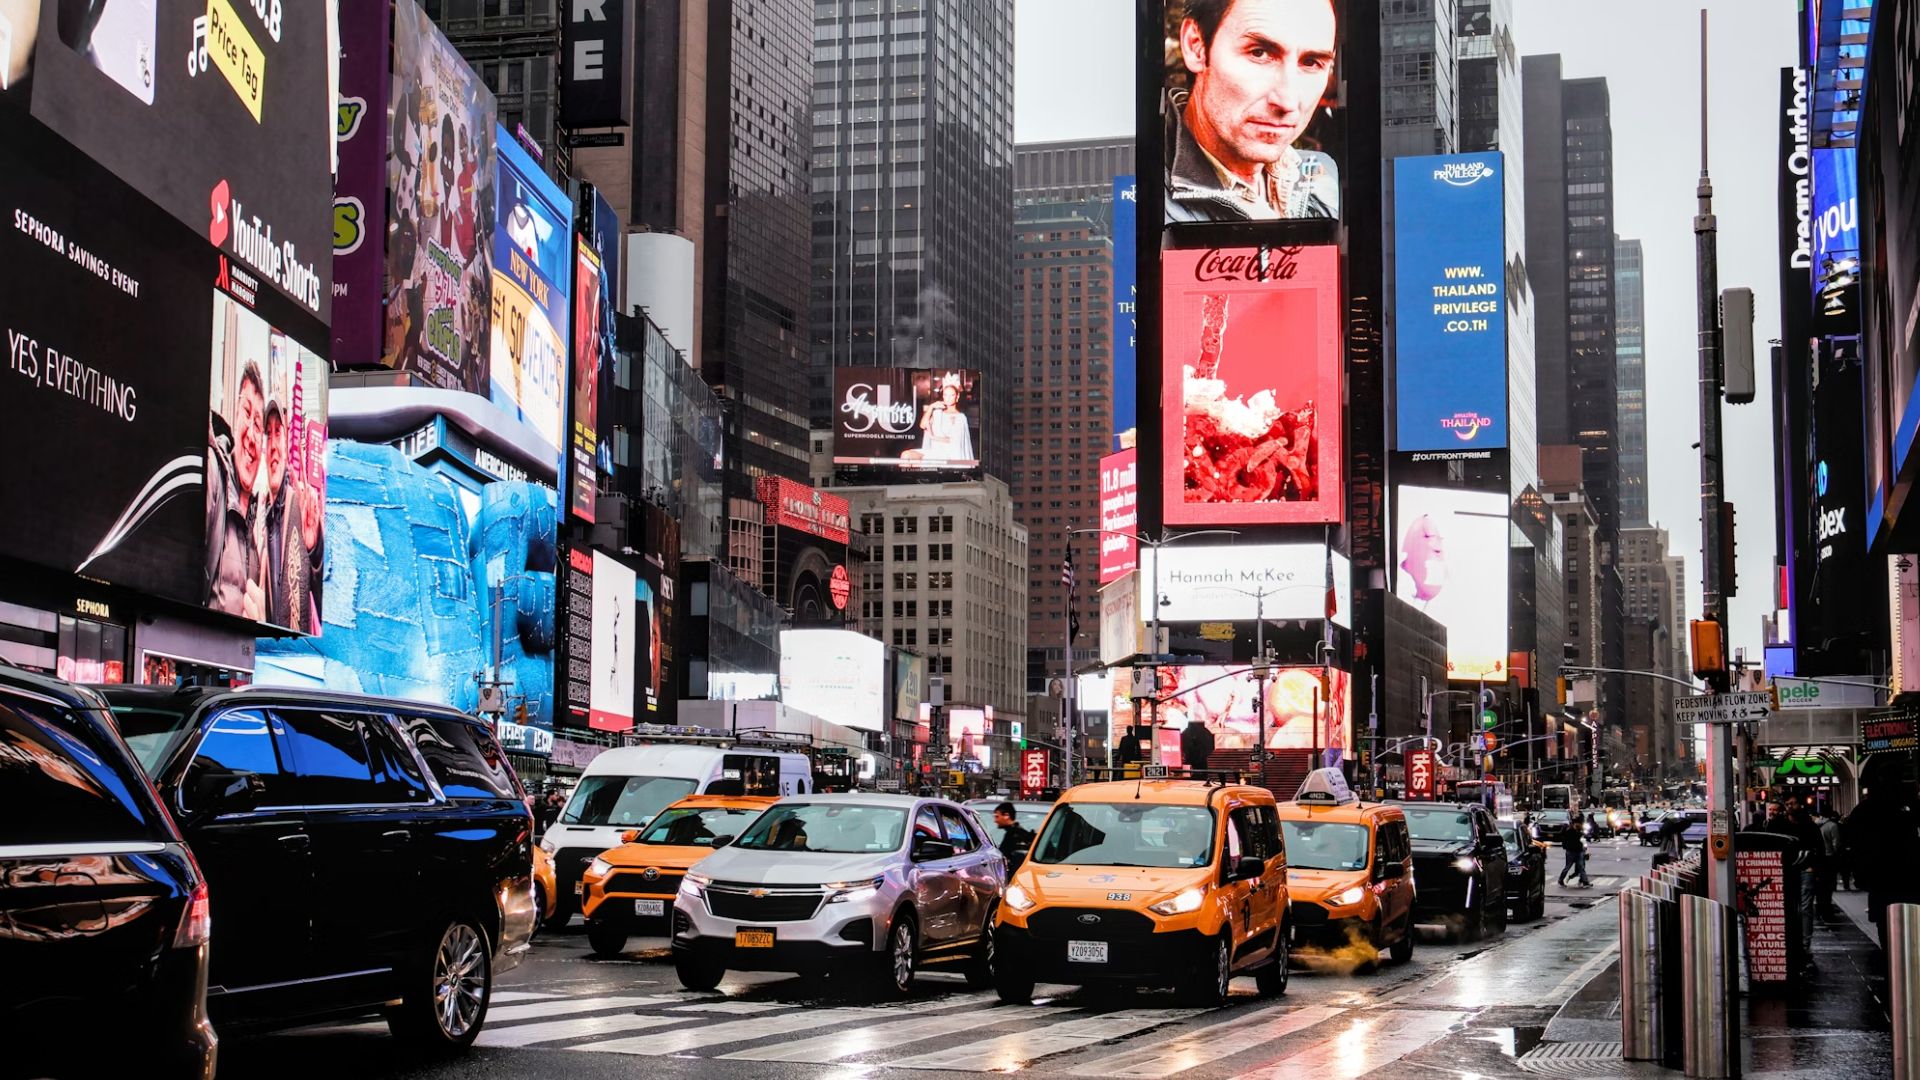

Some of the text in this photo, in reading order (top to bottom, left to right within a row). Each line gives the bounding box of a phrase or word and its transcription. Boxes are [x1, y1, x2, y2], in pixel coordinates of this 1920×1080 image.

[211, 7, 258, 101] Price Tag
[1434, 168, 1481, 180] PRIVILEGE
[1443, 162, 1485, 171] THAILAND
[1820, 198, 1857, 255] you
[14, 208, 140, 299] SEPHORA SAVINGS EVENT
[231, 198, 320, 312] YouTube Shorts
[231, 265, 259, 292] MARRIOTT
[510, 247, 550, 311] NEW YORK
[1444, 266, 1485, 279] WWW.
[1433, 283, 1497, 297] THAILAND
[493, 288, 506, 344] #1
[1433, 301, 1497, 315] PRIVILEGE
[1443, 319, 1488, 333] .CO.TH
[8, 328, 137, 422] YES, EVERYTHING
[1440, 418, 1491, 428] THAILAND
[475, 447, 509, 481] AMERICAN
[1412, 451, 1491, 461] #OUTFRONTPRIME
[1103, 468, 1119, 493] 11.8
[1170, 567, 1296, 584] Hannah McKee
[76, 599, 110, 618] SEPHORA
[1675, 693, 1770, 709] PEDESTRIAN FLOW ZONE
[1676, 709, 1729, 723] KEEP MOVING
[1027, 753, 1040, 788] tkts
[1412, 752, 1430, 790] tkts
[1745, 859, 1783, 867] CRIMINAL
[1753, 851, 1783, 859] MONEY
[1106, 893, 1132, 901] 938
[1071, 946, 1105, 958] Y209305C
